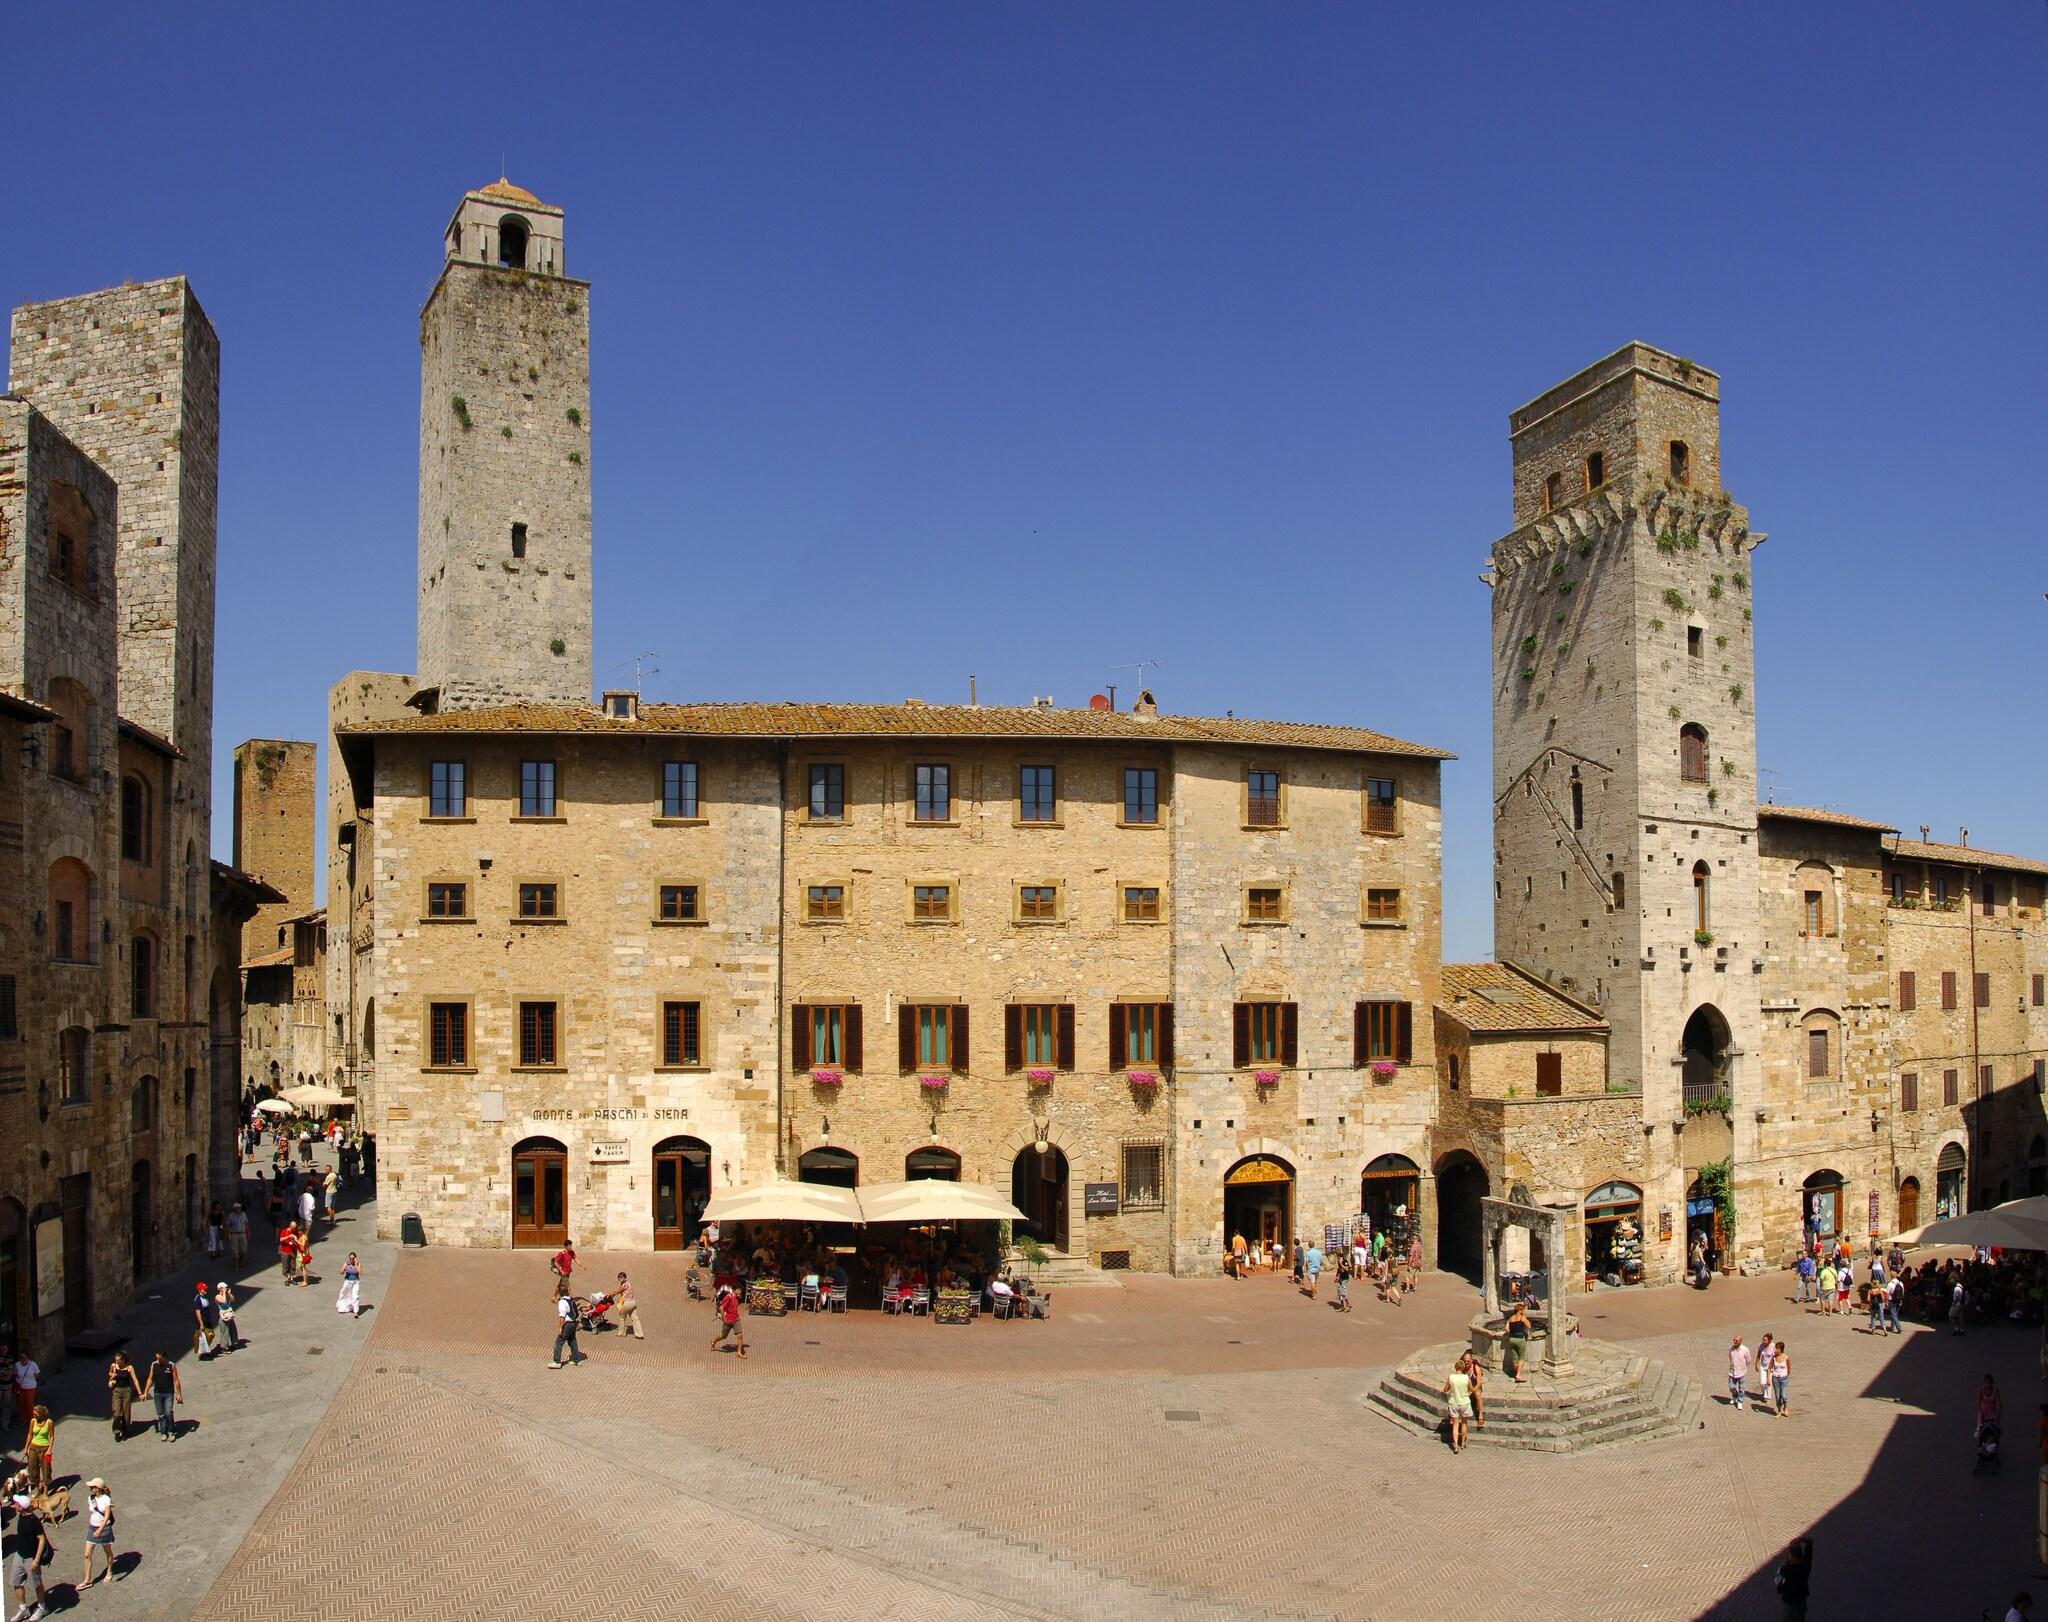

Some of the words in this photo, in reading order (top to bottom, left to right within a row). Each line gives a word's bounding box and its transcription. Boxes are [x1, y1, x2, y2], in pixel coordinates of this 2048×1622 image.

[532, 1109, 573, 1121] MONTE
[594, 1109, 637, 1121] PASCHI
[655, 1109, 689, 1120] SIENA
